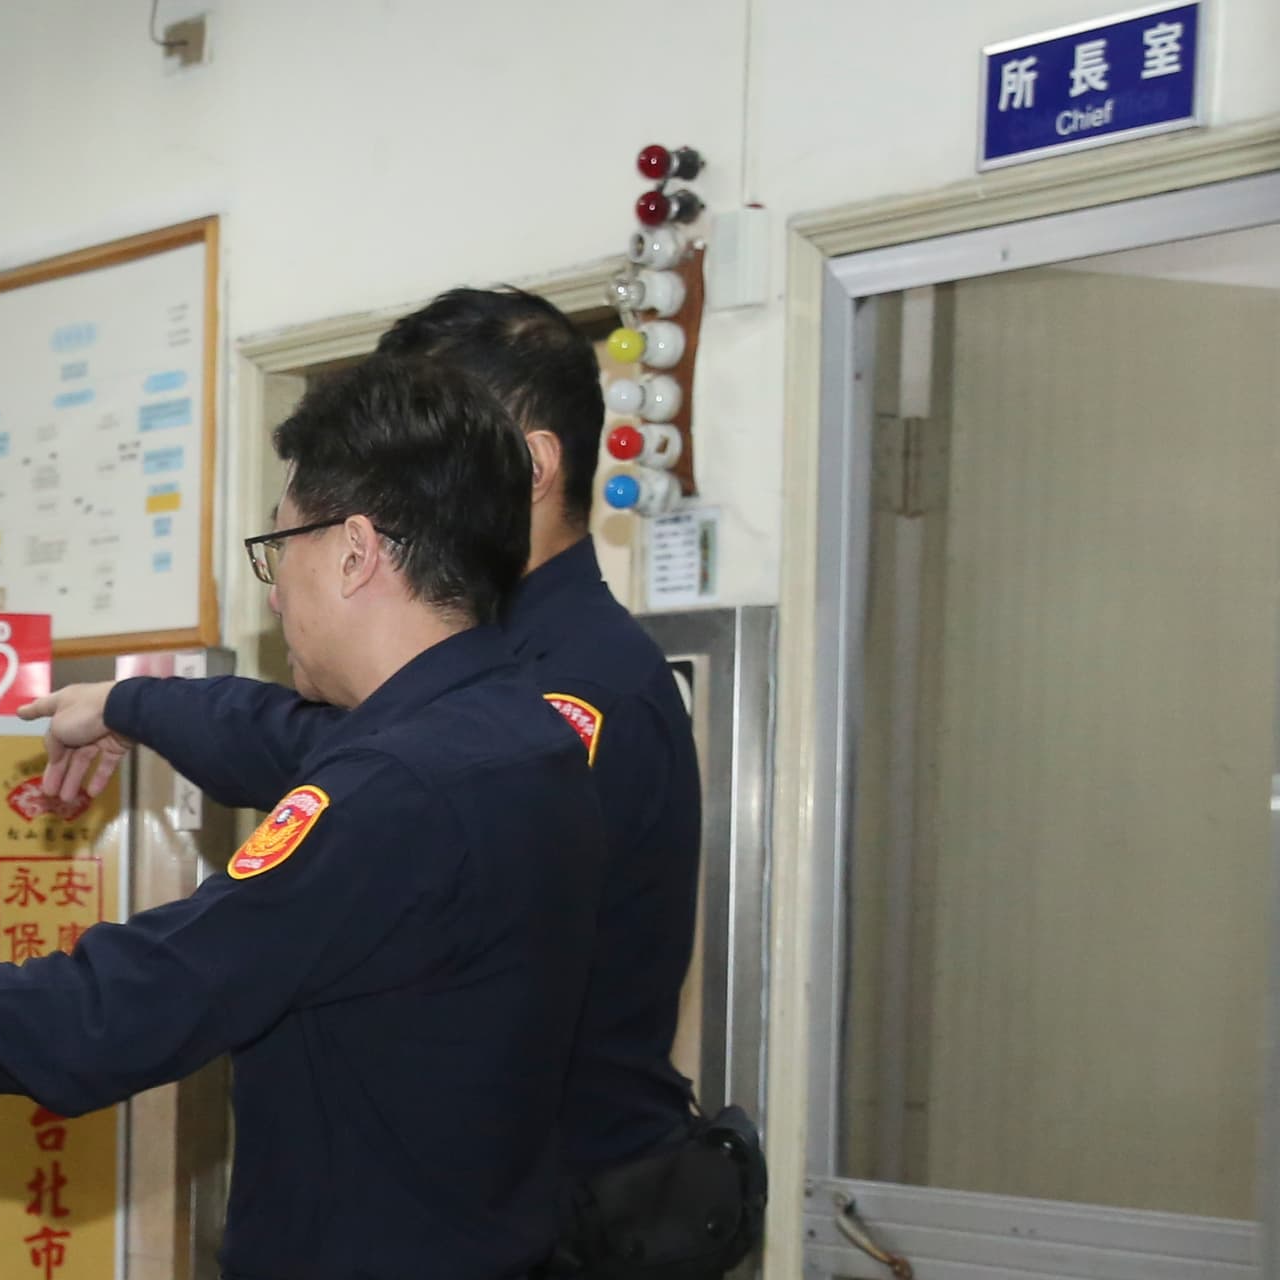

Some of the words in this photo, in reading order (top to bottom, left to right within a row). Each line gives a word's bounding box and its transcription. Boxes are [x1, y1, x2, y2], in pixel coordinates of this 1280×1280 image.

[998, 22, 1184, 112] 所長室
[1055, 99, 1115, 136] Chief
